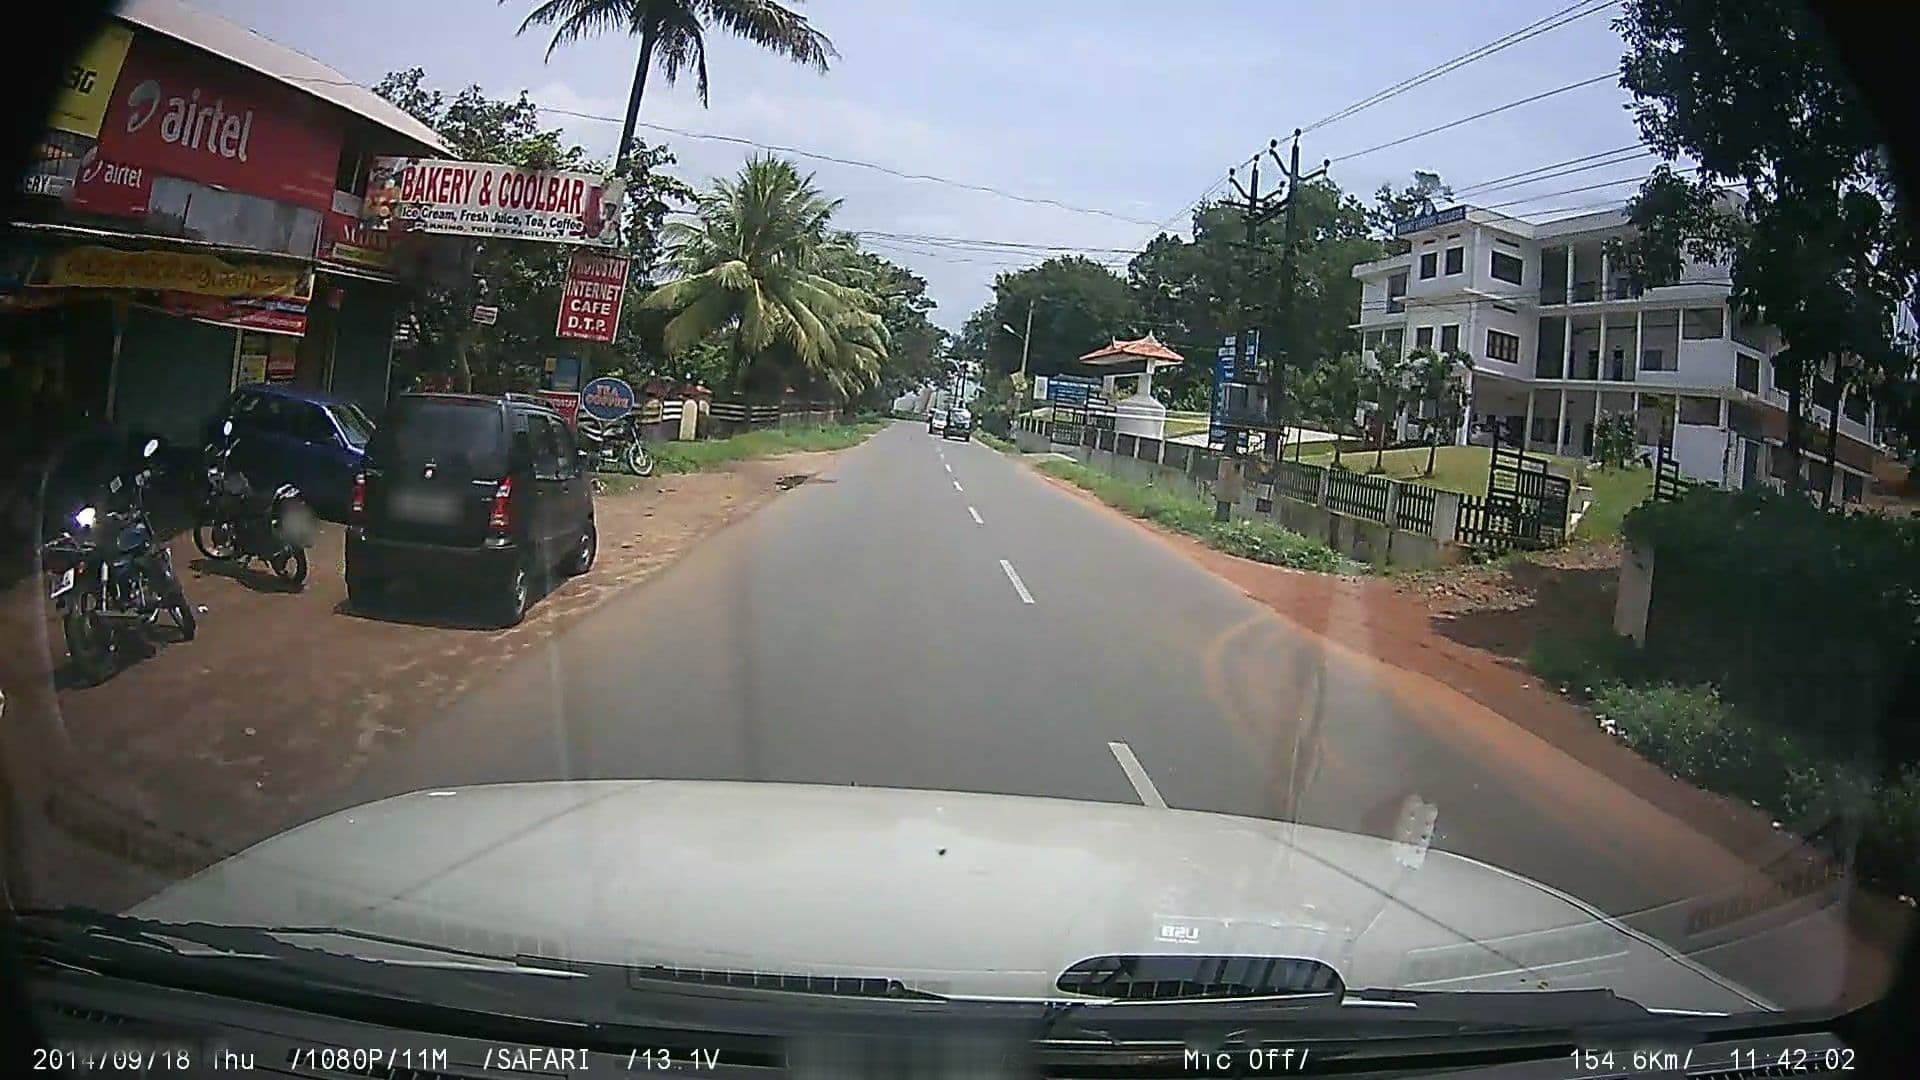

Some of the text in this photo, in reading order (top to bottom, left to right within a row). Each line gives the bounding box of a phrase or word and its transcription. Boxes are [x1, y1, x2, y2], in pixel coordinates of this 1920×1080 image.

[161, 87, 253, 162] airtel
[104, 163, 142, 188] airtel
[400, 165, 585, 215] BAKERY & COOLBAR
[401, 206, 583, 231] Ice Cream, Fresh Juice, Tea, Coffee
[566, 279, 621, 302] INTERNET
[571, 299, 611, 316] CAFE
[567, 316, 607, 332] D.T.P.
